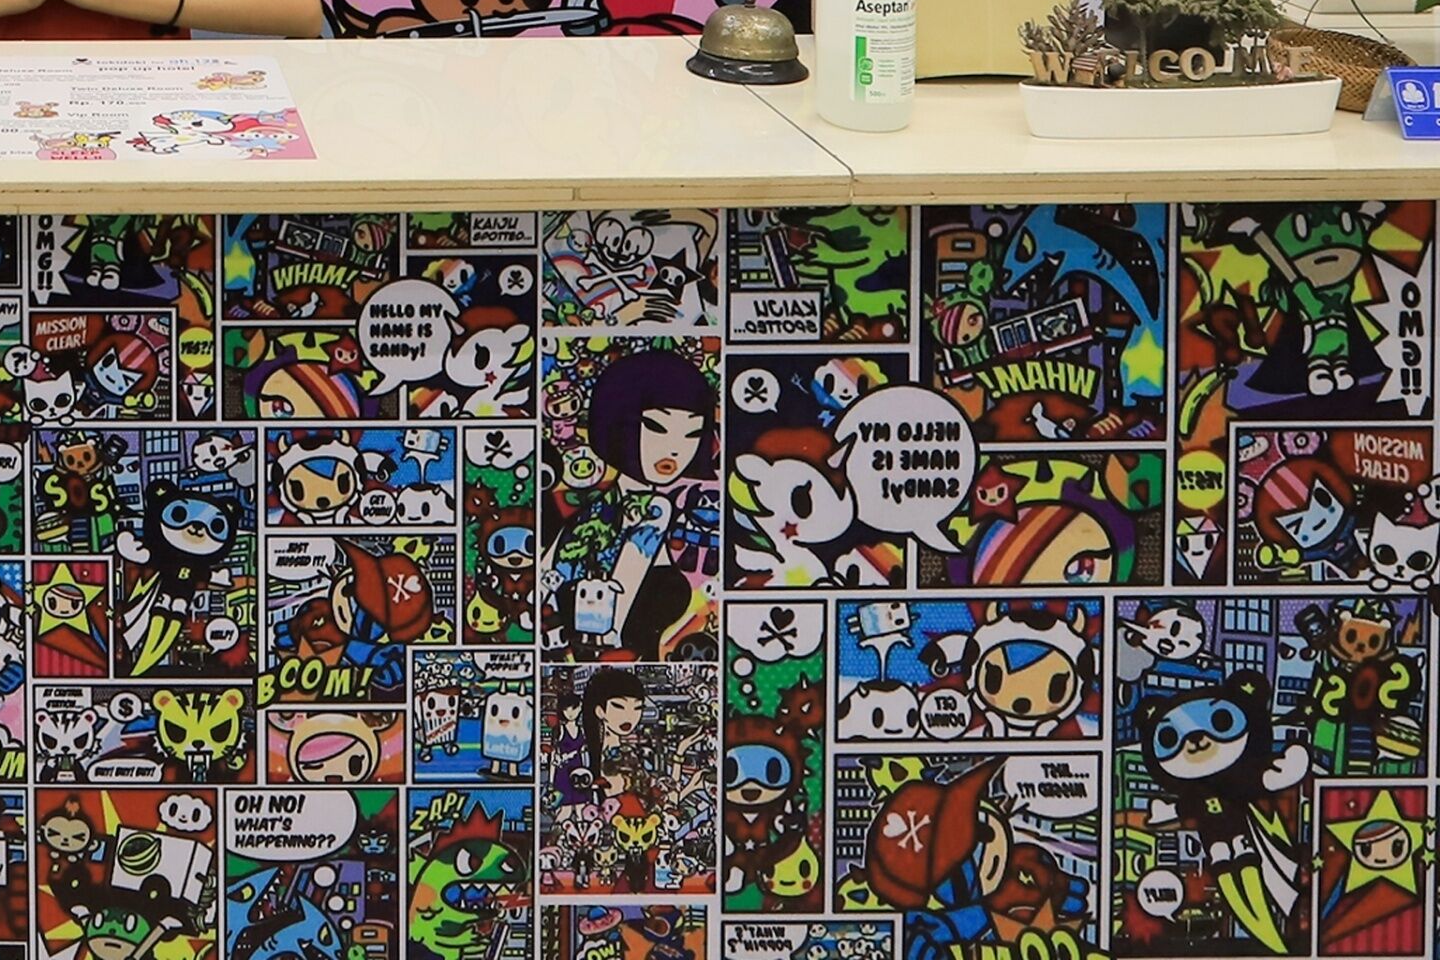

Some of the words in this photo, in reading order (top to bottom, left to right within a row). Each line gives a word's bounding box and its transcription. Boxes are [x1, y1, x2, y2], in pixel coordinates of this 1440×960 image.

[1029, 45, 1315, 83] WLCOME
[473, 216, 518, 231] KAIJU
[272, 263, 359, 292] WHAM!
[369, 303, 415, 319] HELLO
[419, 303, 443, 319] MY
[35, 315, 87, 336] MISSION
[369, 323, 413, 339] NAME
[417, 323, 433, 339] IS
[46, 329, 87, 352] CLEAR!
[369, 494, 386, 506] GET
[118, 697, 134, 718] $
[234, 794, 264, 814] OH
[268, 793, 306, 814] NO!
[410, 792, 466, 831] ZAP!
[234, 816, 293, 832] WHAT'S
[235, 834, 336, 848] HAPPENING??
[587, 941, 621, 960] OW!
